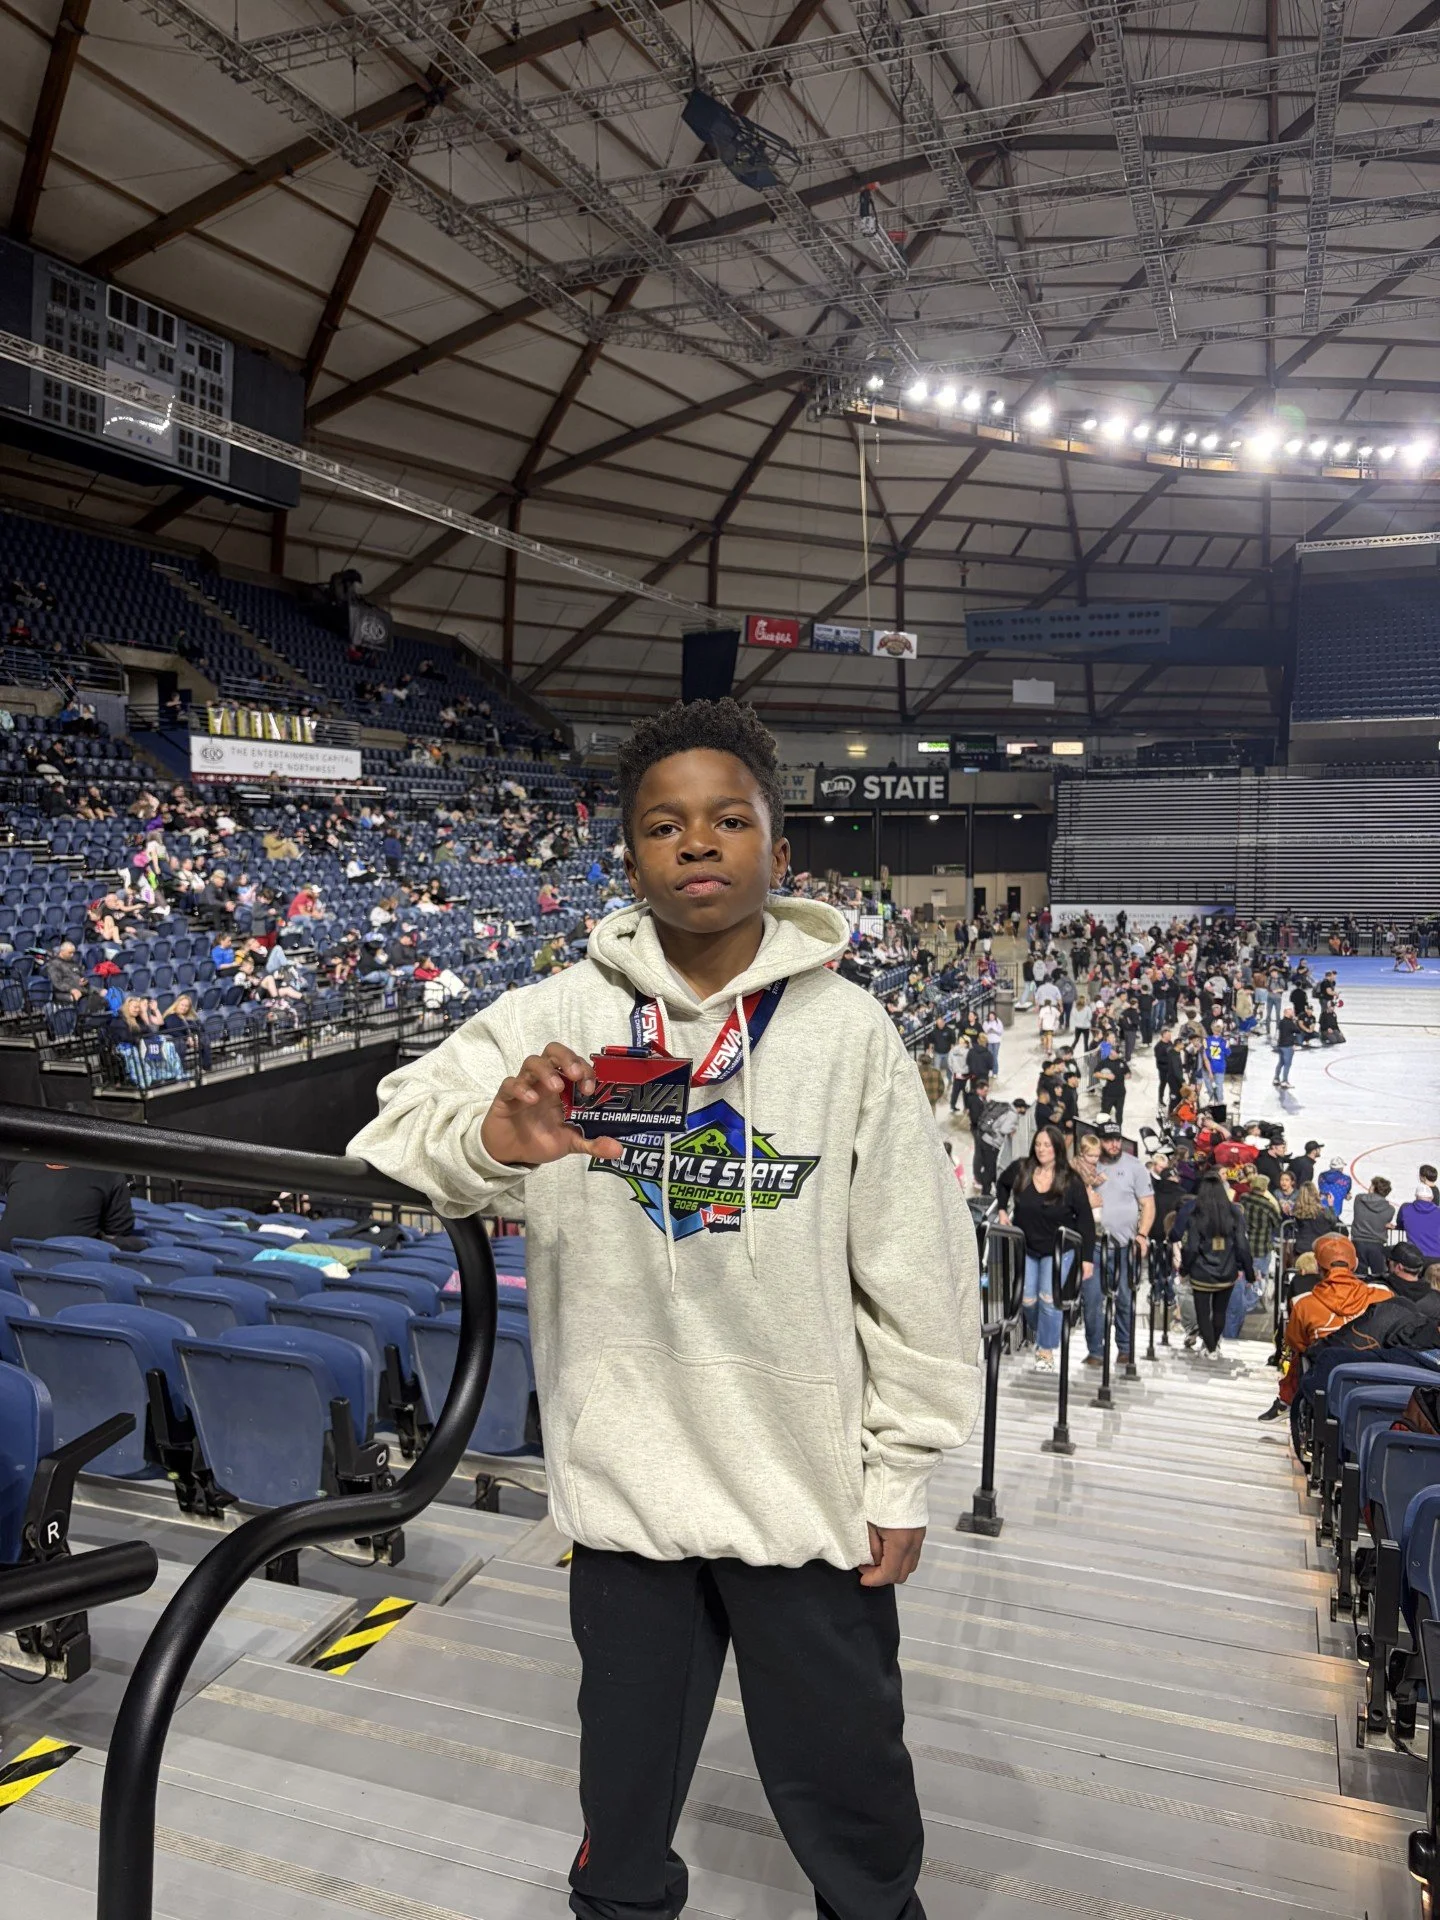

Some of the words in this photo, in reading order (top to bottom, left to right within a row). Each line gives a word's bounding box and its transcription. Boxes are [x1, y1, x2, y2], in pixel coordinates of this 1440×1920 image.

[231, 747, 248, 758] THE
[251, 748, 320, 761] ENTERTAINMENT
[321, 753, 354, 764] CAPITAL
[253, 761, 265, 770] OF
[268, 762, 283, 771] THE
[287, 763, 336, 773] NORTHWEST
[863, 775, 945, 800] STATE
[640, 1001, 659, 1046] WSW
[700, 1027, 742, 1080] WSWA
[573, 1080, 686, 1113] WSWA
[570, 1110, 600, 1121] STATE
[601, 1111, 682, 1125] CHAMPIONSHIPS
[599, 1147, 717, 1185] LKSTYLE
[718, 1161, 799, 1190] STATE
[668, 1185, 778, 1205] CHAMPIONHIP
[674, 1200, 699, 1211] 2026
[706, 1212, 740, 1226] WSWA
[47, 1521, 60, 1544] R
